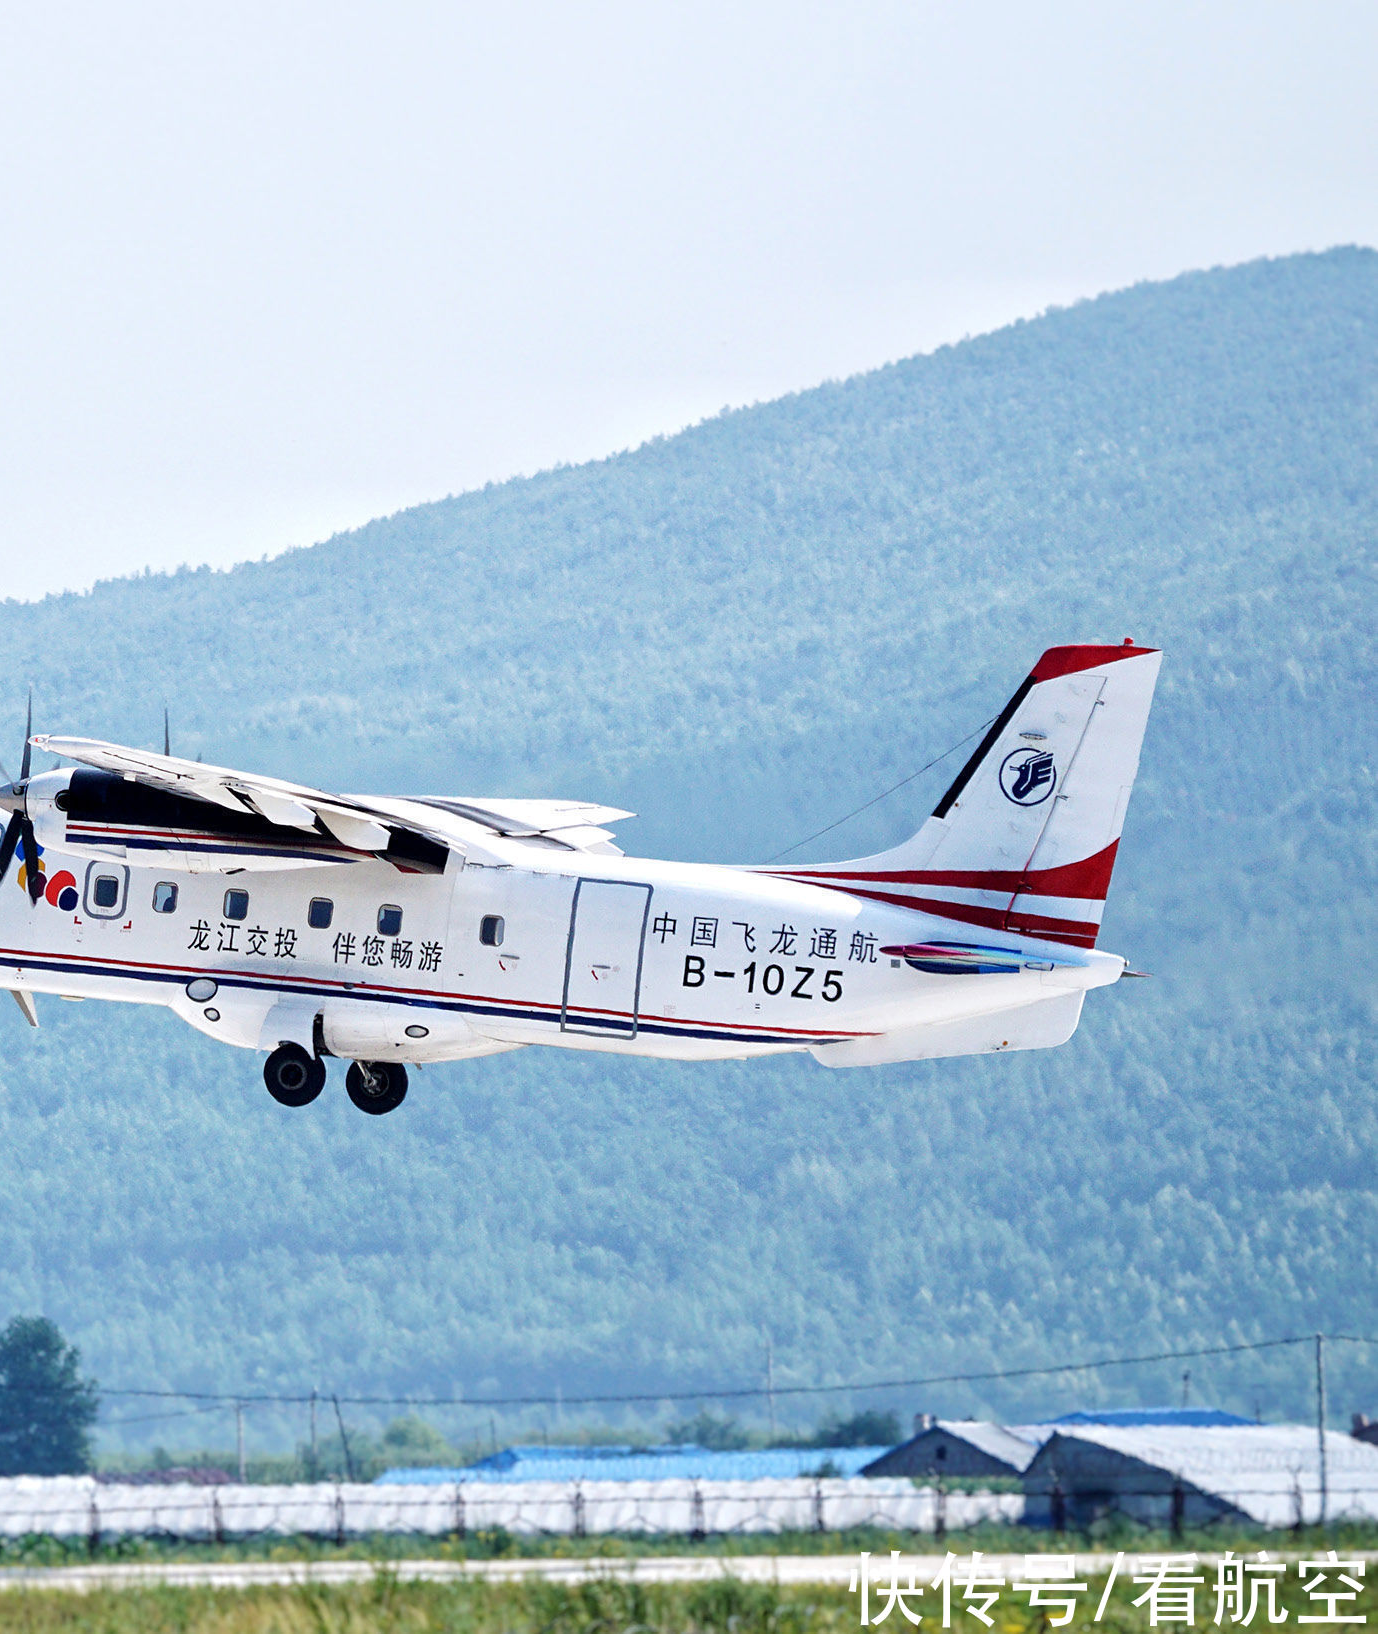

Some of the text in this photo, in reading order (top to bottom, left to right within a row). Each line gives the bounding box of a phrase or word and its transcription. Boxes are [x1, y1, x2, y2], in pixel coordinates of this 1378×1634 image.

[187, 919, 444, 973] 龙江交投 伴您畅游
[652, 911, 879, 964] 中国飞龙通航
[682, 954, 844, 1003] B-10Z5
